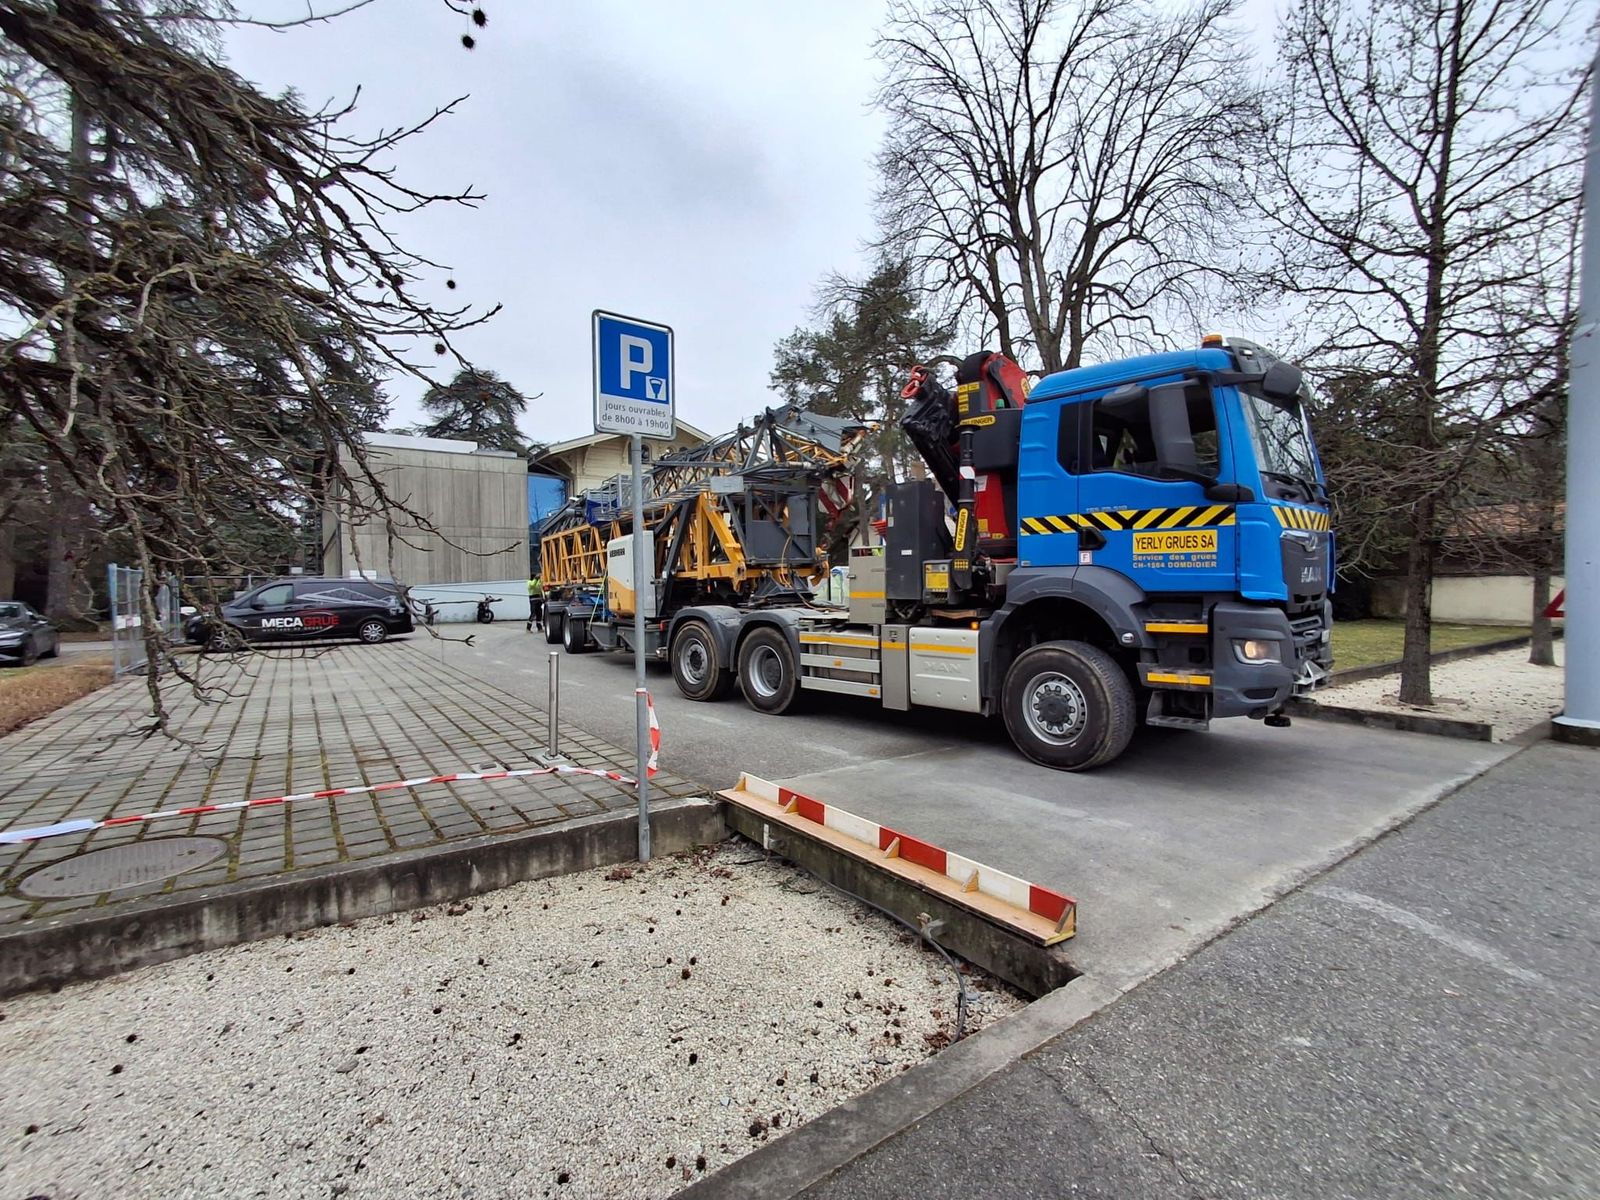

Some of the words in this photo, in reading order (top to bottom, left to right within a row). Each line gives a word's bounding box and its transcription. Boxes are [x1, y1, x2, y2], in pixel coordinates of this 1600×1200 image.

[620, 333, 653, 389] P
[605, 401, 626, 412] jours
[628, 406, 666, 417] ouvrables
[602, 413, 612, 421] de
[615, 414, 635, 425] 8h00
[645, 419, 669, 430] 19h00
[1135, 536, 1163, 550] YERLY
[1165, 535, 1198, 549] GRUES
[1200, 534, 1215, 548] SA
[1167, 561, 1217, 569] DOMDIDIER
[1191, 553, 1217, 561] grues
[261, 616, 339, 627] MECAGRUE
